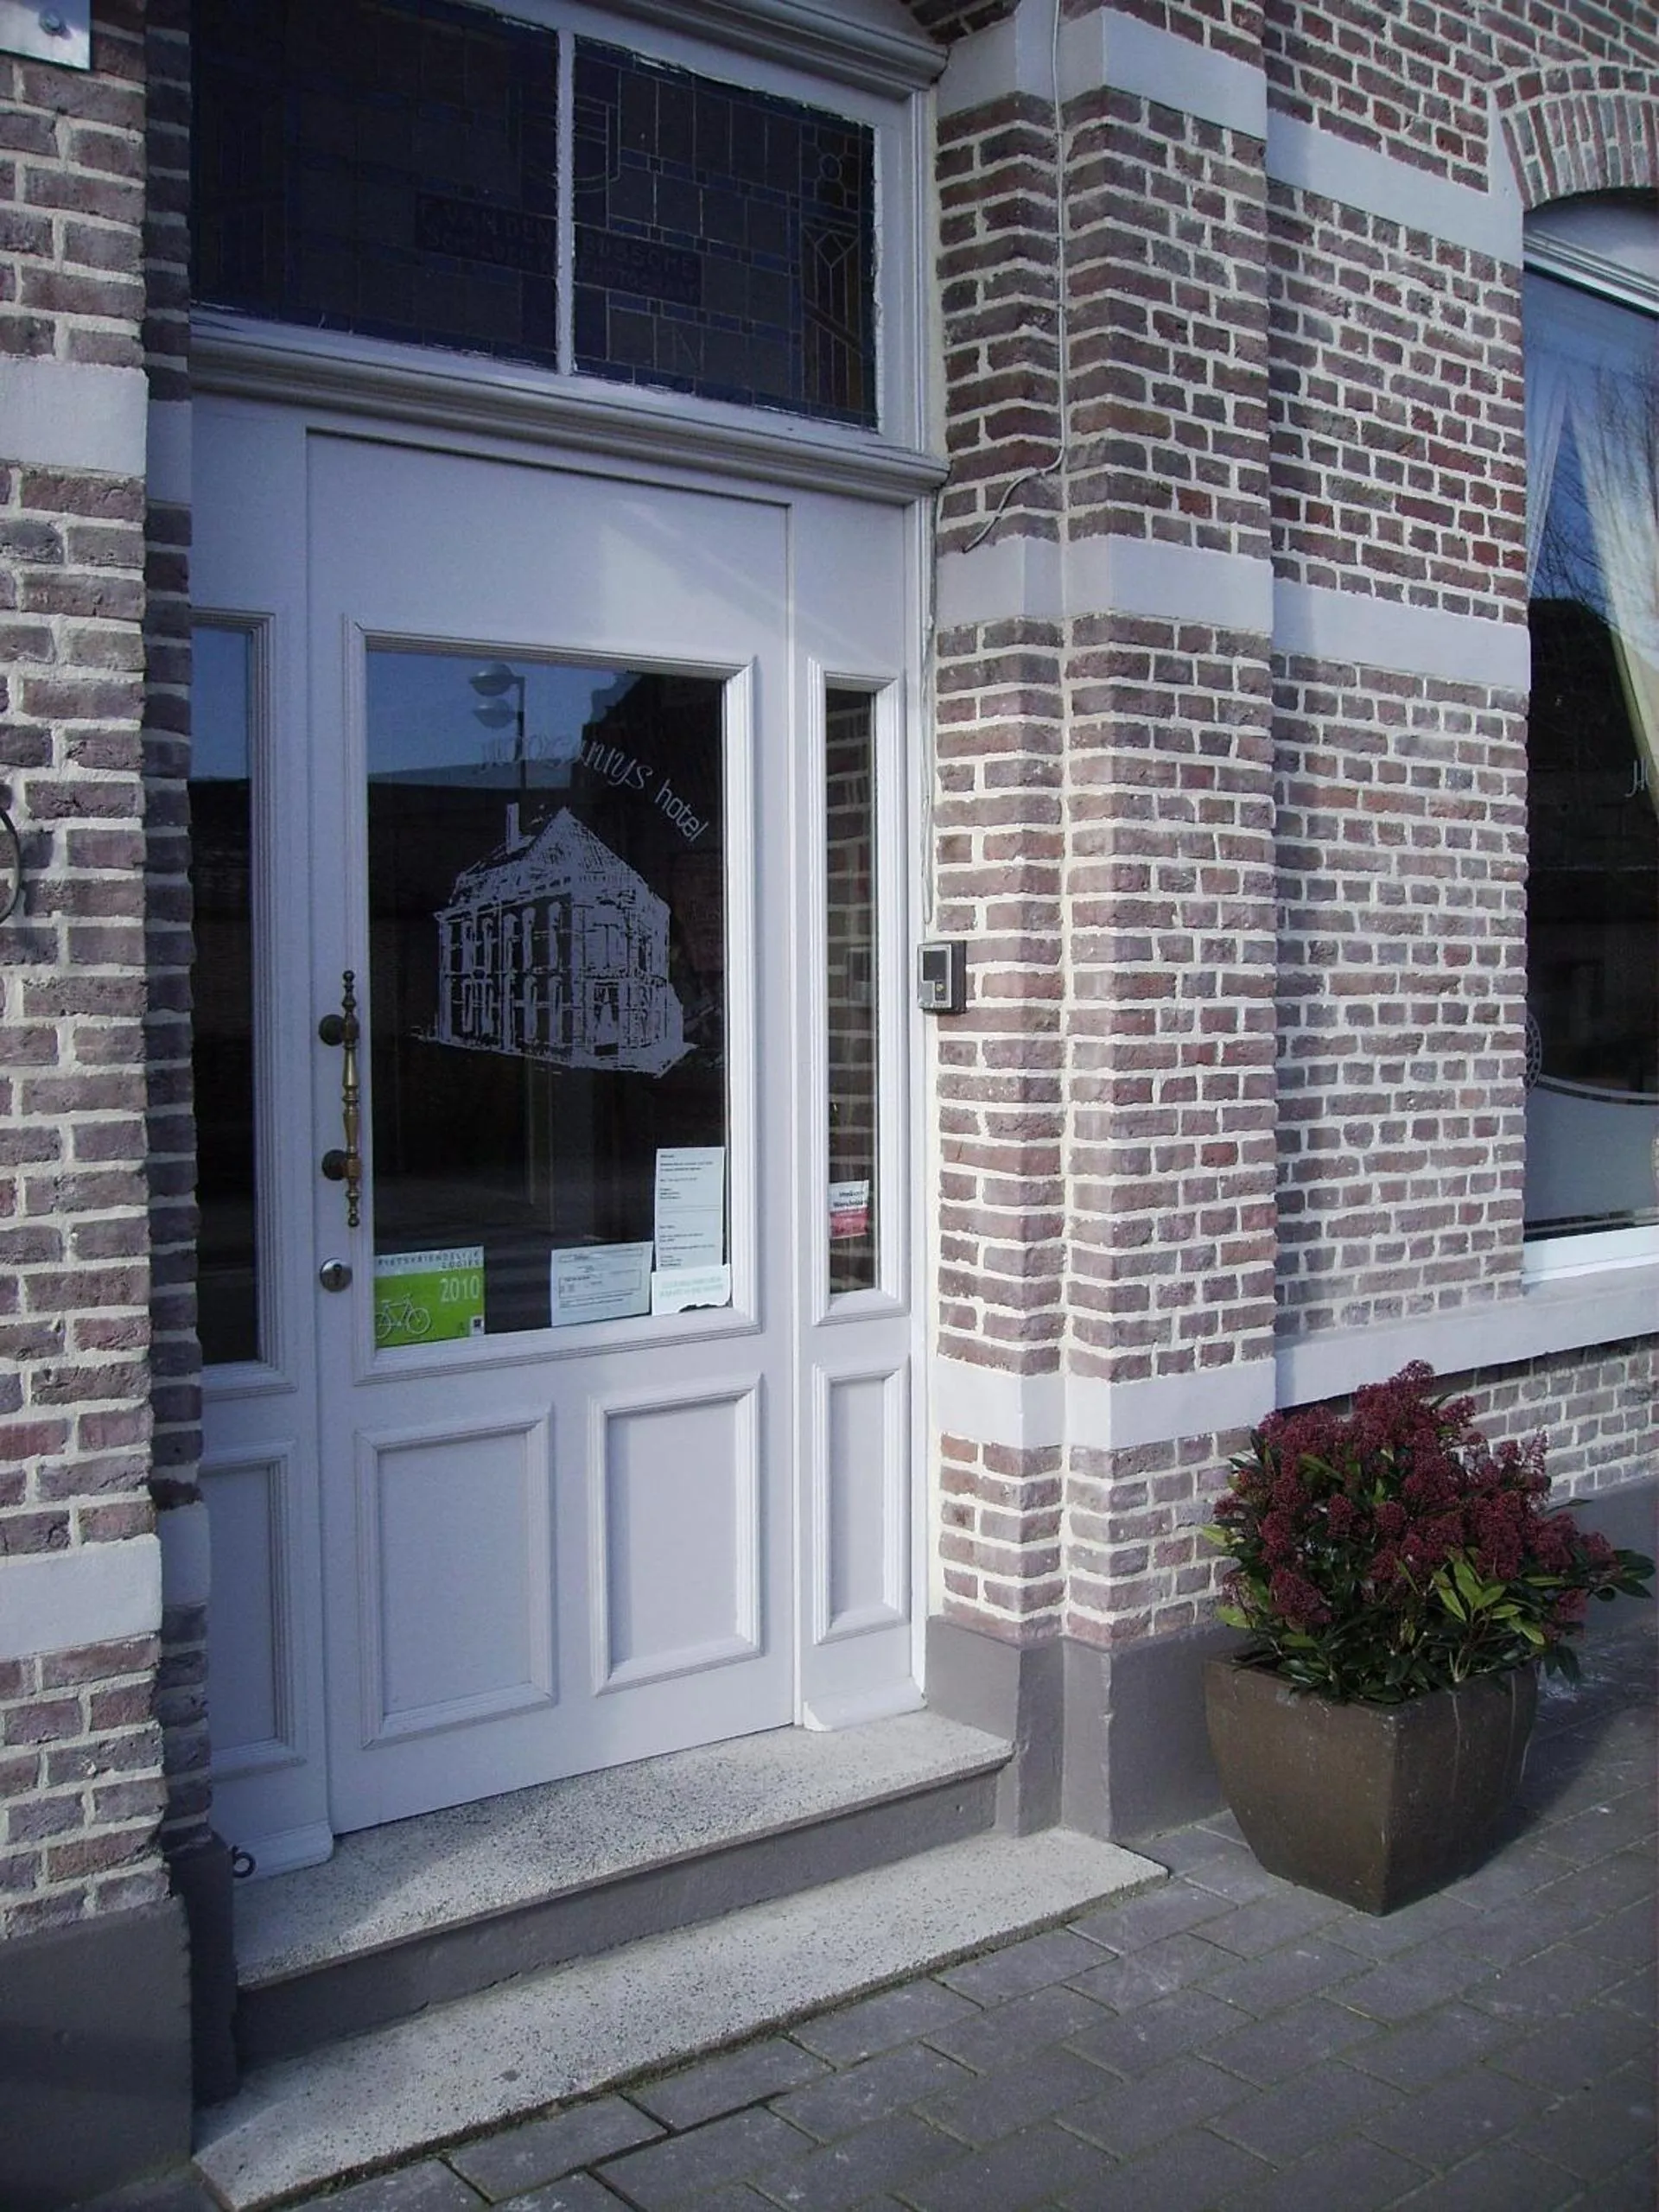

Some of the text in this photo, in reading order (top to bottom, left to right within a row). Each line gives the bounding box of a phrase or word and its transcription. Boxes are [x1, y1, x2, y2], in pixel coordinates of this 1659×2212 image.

[443, 204, 499, 238] VAN
[505, 215, 553, 245] DEN
[654, 778, 709, 842] hotel
[439, 1274, 480, 1303] 2010
